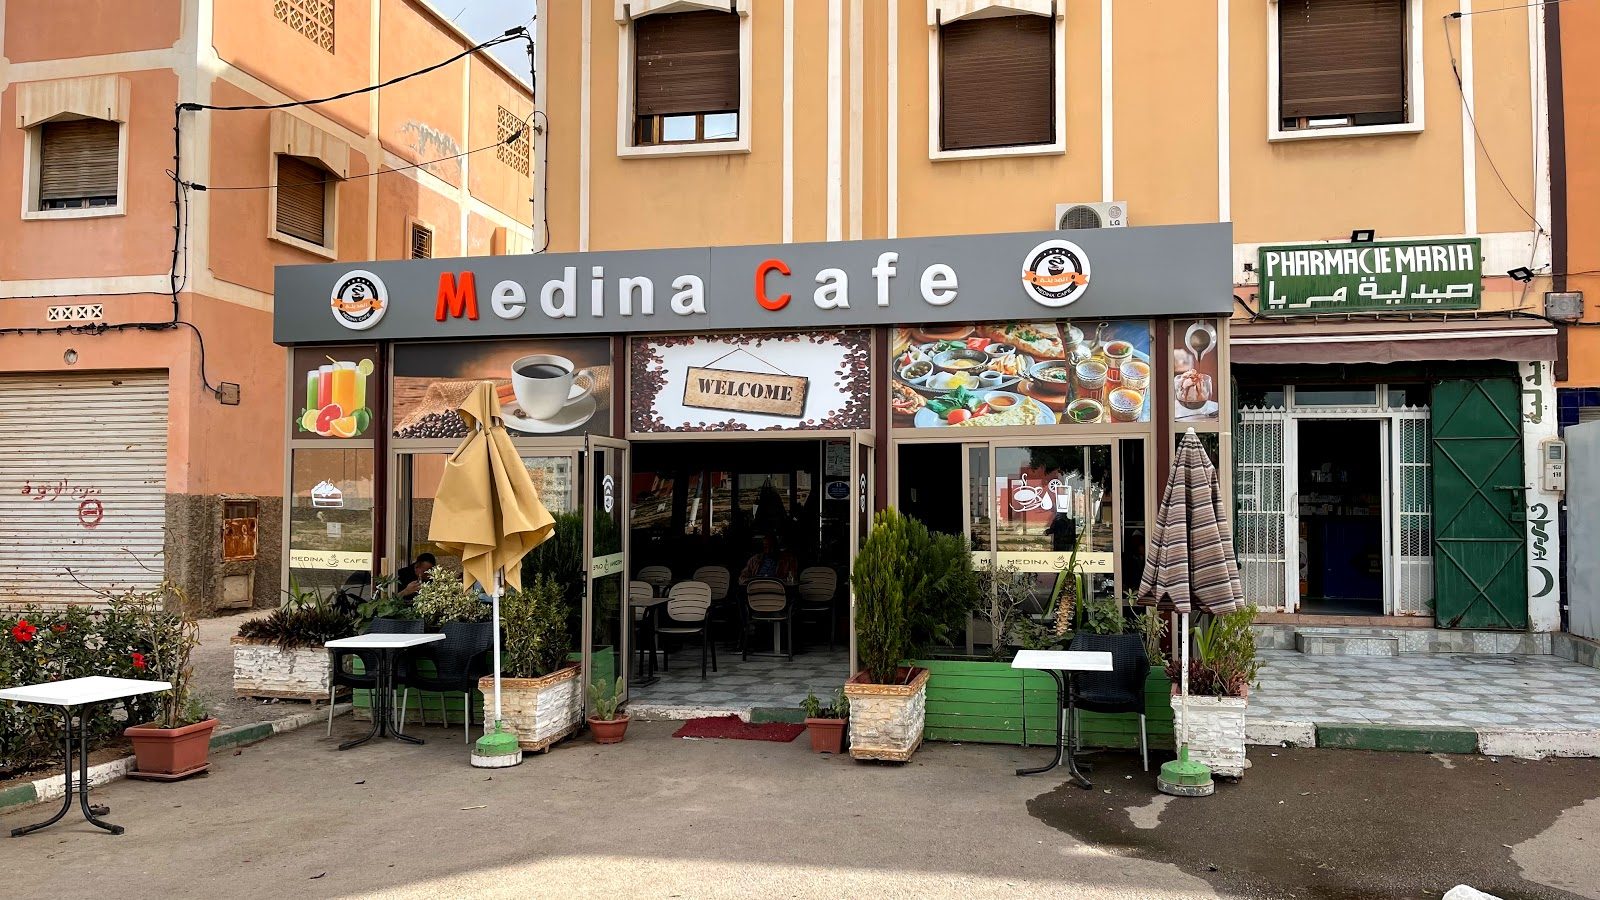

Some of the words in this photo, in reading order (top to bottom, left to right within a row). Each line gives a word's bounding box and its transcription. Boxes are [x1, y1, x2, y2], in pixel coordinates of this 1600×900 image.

[1266, 247, 1392, 277] PHARMACIE
[1395, 244, 1474, 273] MARIA
[434, 265, 707, 322] Medina
[754, 251, 959, 311] Cafe
[1036, 286, 1055, 298] MEDINA
[1057, 287, 1073, 298] CAFE
[1358, 275, 1473, 304] صيدلية
[698, 378, 793, 401] WELCOME
